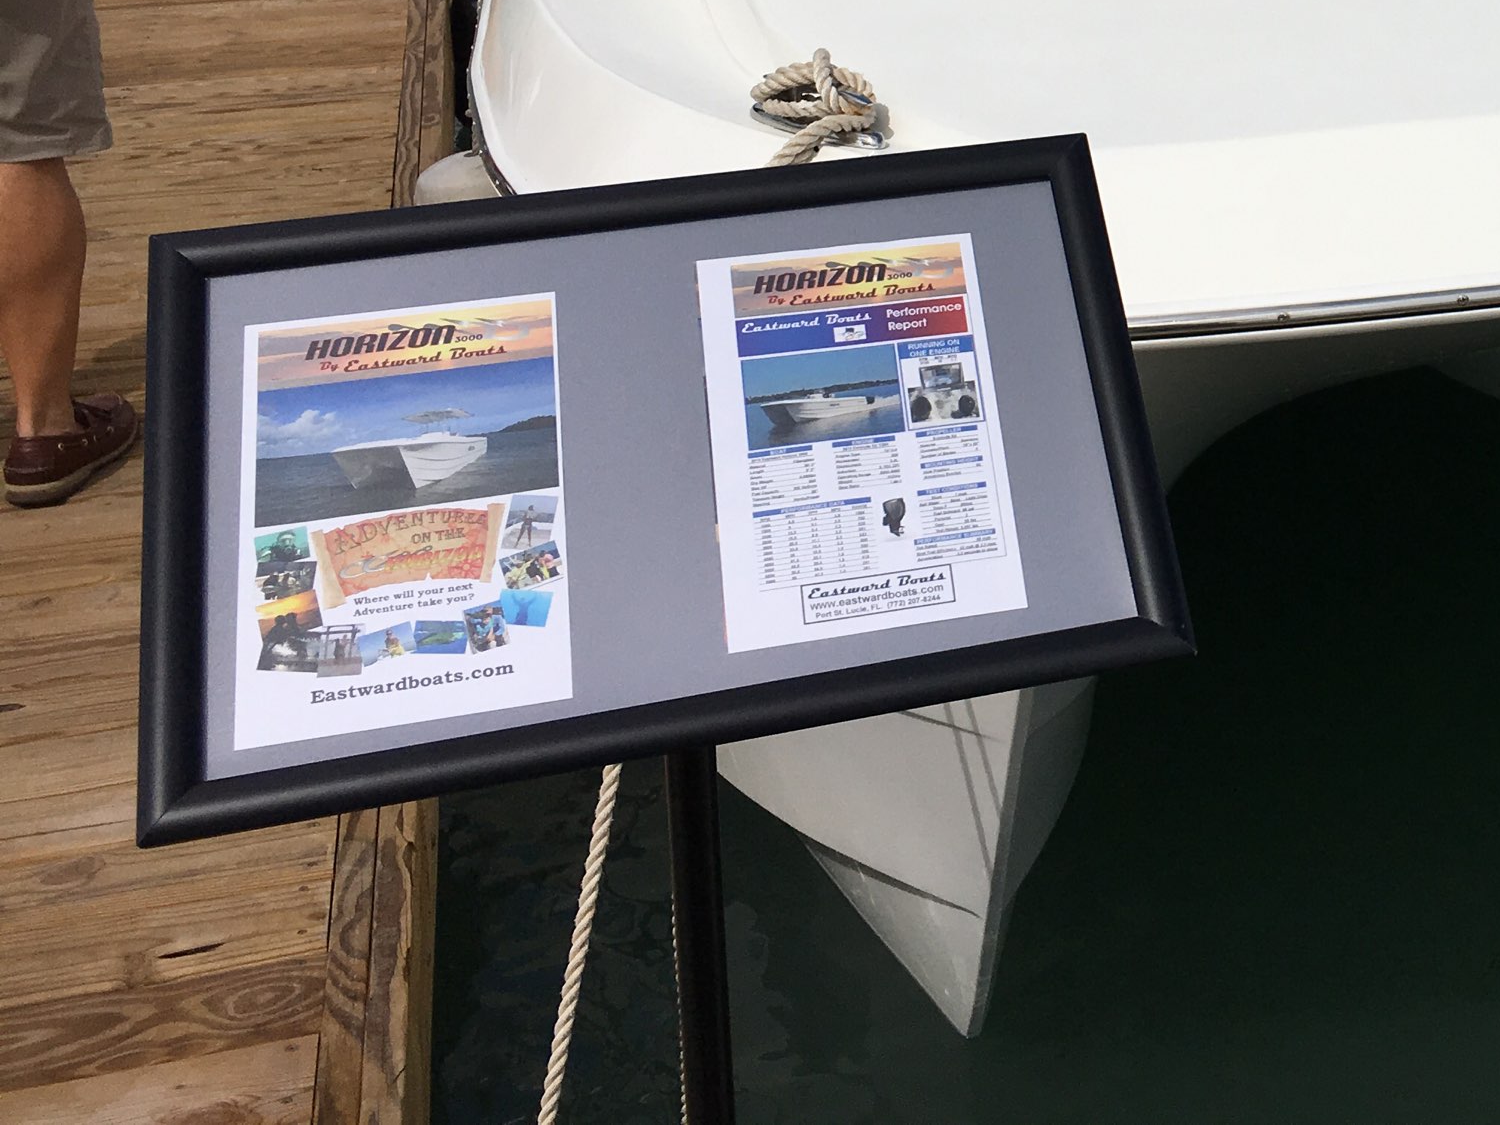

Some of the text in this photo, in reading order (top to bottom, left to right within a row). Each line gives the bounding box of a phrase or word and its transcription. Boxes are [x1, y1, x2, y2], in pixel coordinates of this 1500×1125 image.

[753, 263, 913, 295] HORIZON 3000
[767, 282, 936, 306] By Eastward Boats
[741, 311, 872, 334] Eastward Boats
[886, 302, 962, 319] Performance
[888, 318, 927, 331] Report
[305, 324, 483, 360] HORIZON 3000
[907, 338, 961, 350] RUNNING ON
[909, 346, 961, 357] ONE ENGINE
[320, 345, 507, 373] By Eastward Boats
[411, 527, 466, 544] ON THE
[353, 582, 474, 606] Where will your next
[808, 572, 946, 599] Eastward Boats
[810, 584, 944, 610] www.eastwardboats.com
[353, 593, 475, 617] Adventure take you?
[816, 610, 832, 619] Port
[310, 663, 515, 704] Eastwardboats.com
